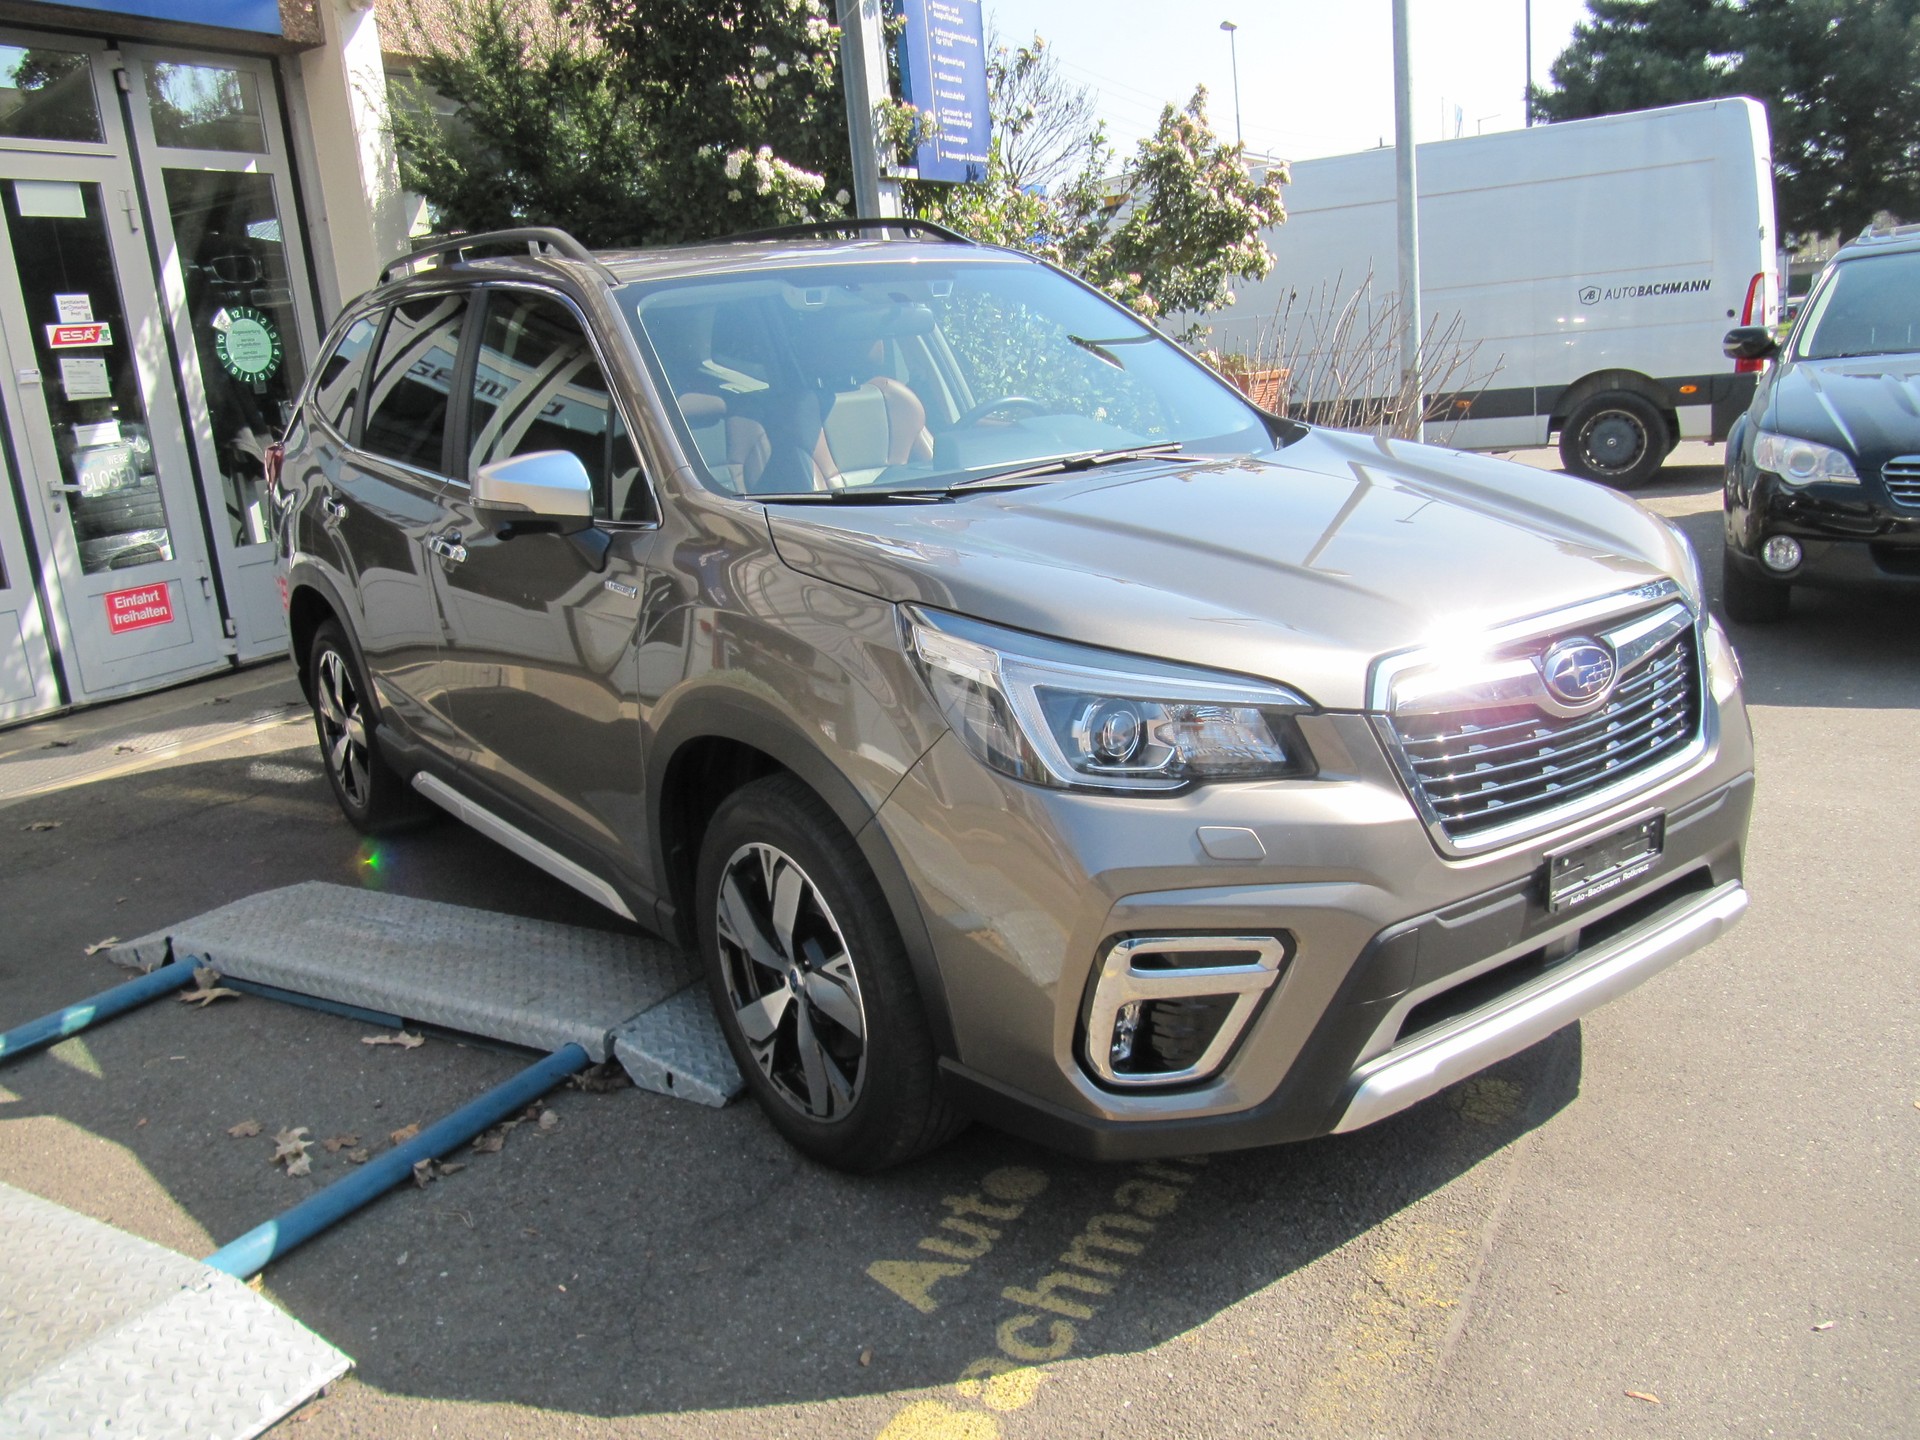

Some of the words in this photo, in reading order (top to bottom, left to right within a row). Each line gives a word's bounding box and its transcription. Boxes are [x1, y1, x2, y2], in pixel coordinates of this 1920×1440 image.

[231, 310, 240, 318] 12
[82, 466, 136, 491] CLOSED
[114, 590, 160, 609] Einfahrt
[114, 606, 168, 625] freihalten
[865, 1165, 1049, 1314] Auto
